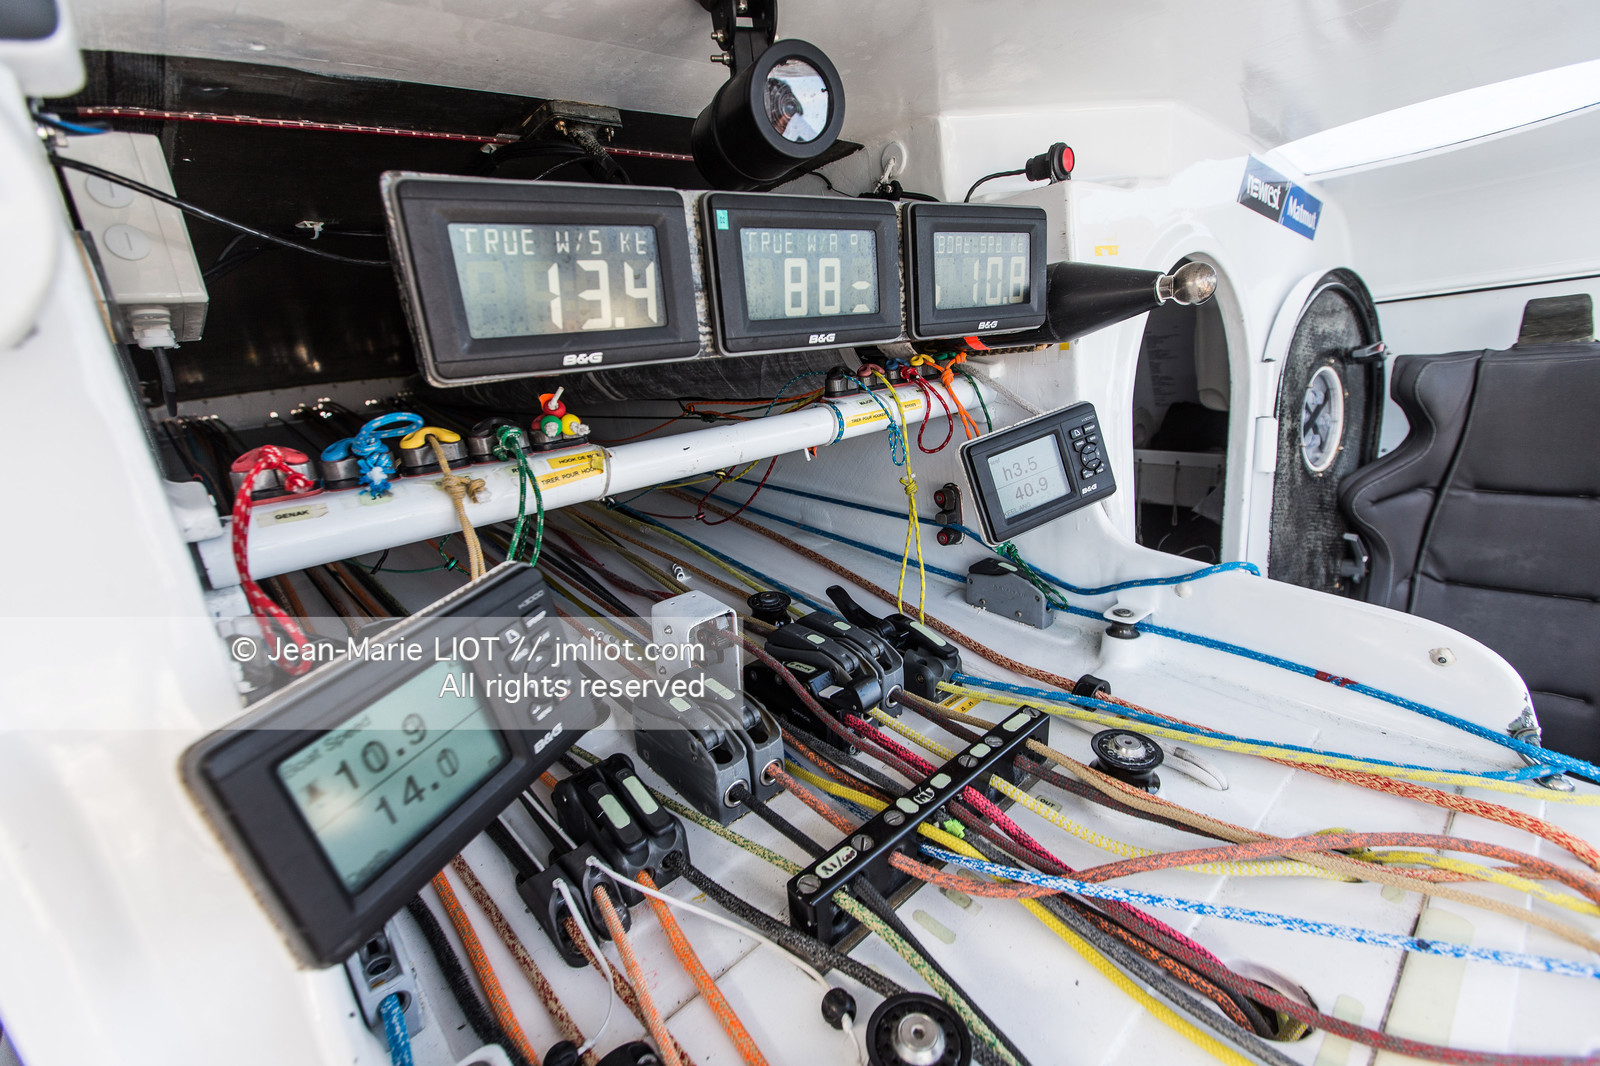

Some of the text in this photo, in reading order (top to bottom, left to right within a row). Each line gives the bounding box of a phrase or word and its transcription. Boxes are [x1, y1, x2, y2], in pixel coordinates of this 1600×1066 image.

[459, 228, 535, 255] TRUE
[555, 229, 602, 255] W/S
[745, 231, 793, 254] TRUE
[972, 256, 1026, 305] 10.8
[547, 259, 658, 330] 13.4
[977, 320, 999, 330] B&G
[808, 333, 836, 344] B&G
[562, 352, 604, 366] B&G
[540, 476, 560, 486] TIRER
[561, 470, 579, 479] POUR
[1015, 476, 1049, 500] 40.9
[1081, 483, 1098, 495] B&G
[533, 722, 563, 755] B&G
[334, 712, 428, 790] 10.9
[374, 747, 461, 825] 14.0
[1039, 798, 1056, 808] OUT
